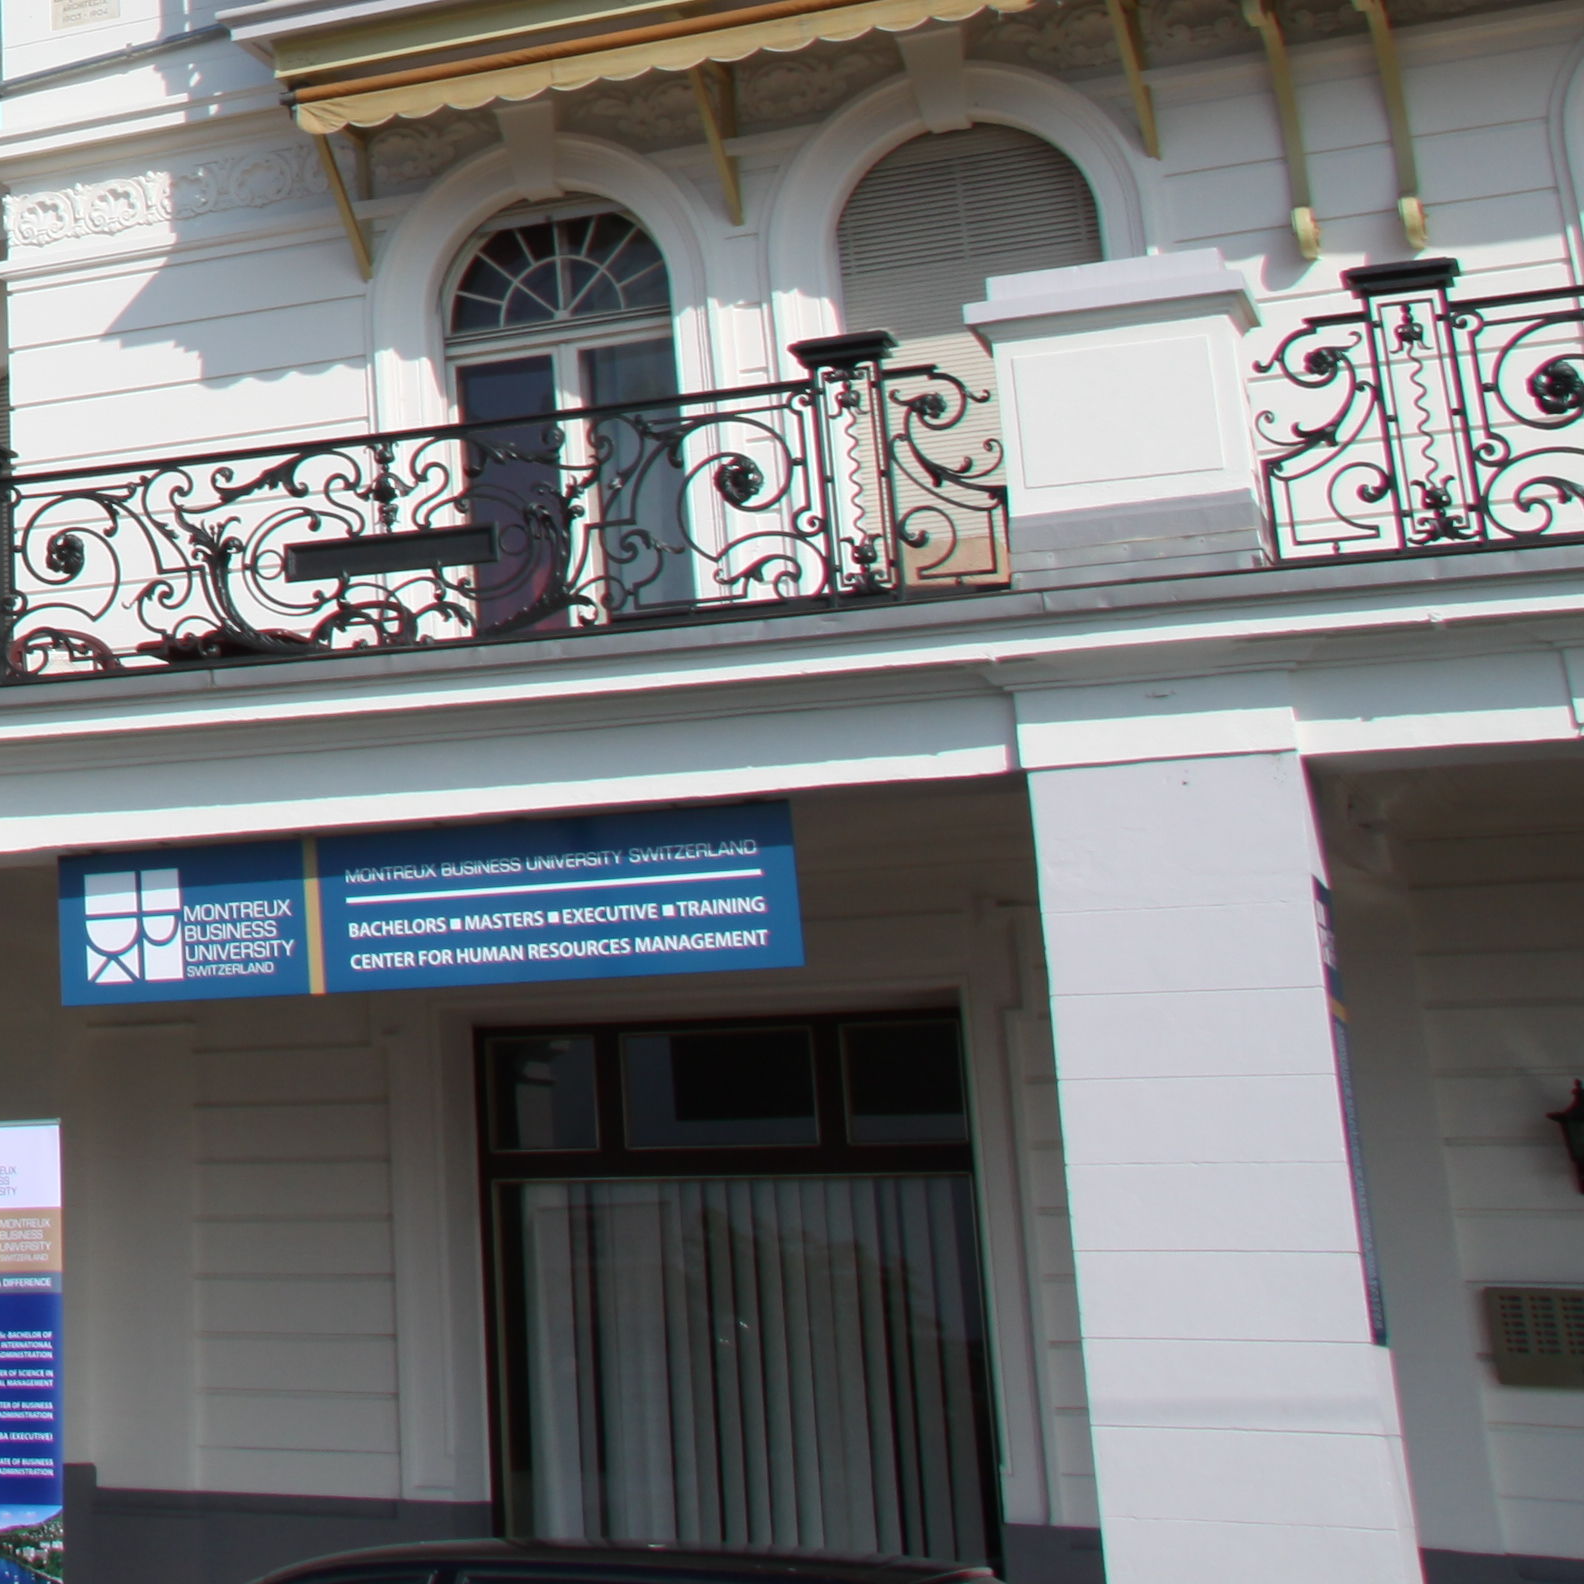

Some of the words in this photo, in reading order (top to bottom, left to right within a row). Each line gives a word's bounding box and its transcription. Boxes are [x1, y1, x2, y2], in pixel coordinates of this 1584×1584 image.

[345, 864, 437, 884] MONTREUX
[441, 858, 521, 877] BUSINESS
[526, 849, 622, 871] UNIVERSITY
[629, 839, 757, 864] SWITZERLAND
[183, 899, 292, 922] MONTREUX
[348, 917, 447, 938] BACHELORS
[464, 910, 544, 931] MASTERS
[562, 903, 658, 925] EXECUTIVE
[676, 896, 766, 917] TRAINING
[184, 920, 277, 942] BUSINESS
[185, 939, 295, 962] UNIVERSITY
[350, 951, 416, 970] CENTER
[418, 948, 453, 966] FOR
[456, 944, 524, 964] HUMAN
[527, 937, 631, 960] RESOURCES
[634, 929, 768, 953] MANAGEMENT
[186, 961, 274, 977] SWITZERLAND
[0, 1218, 51, 1229] MONTREUX
[0, 1229, 44, 1240] BUSINESS
[0, 1241, 52, 1252] UNIVERSITY
[3, 1277, 52, 1288] DIFFERENCE
